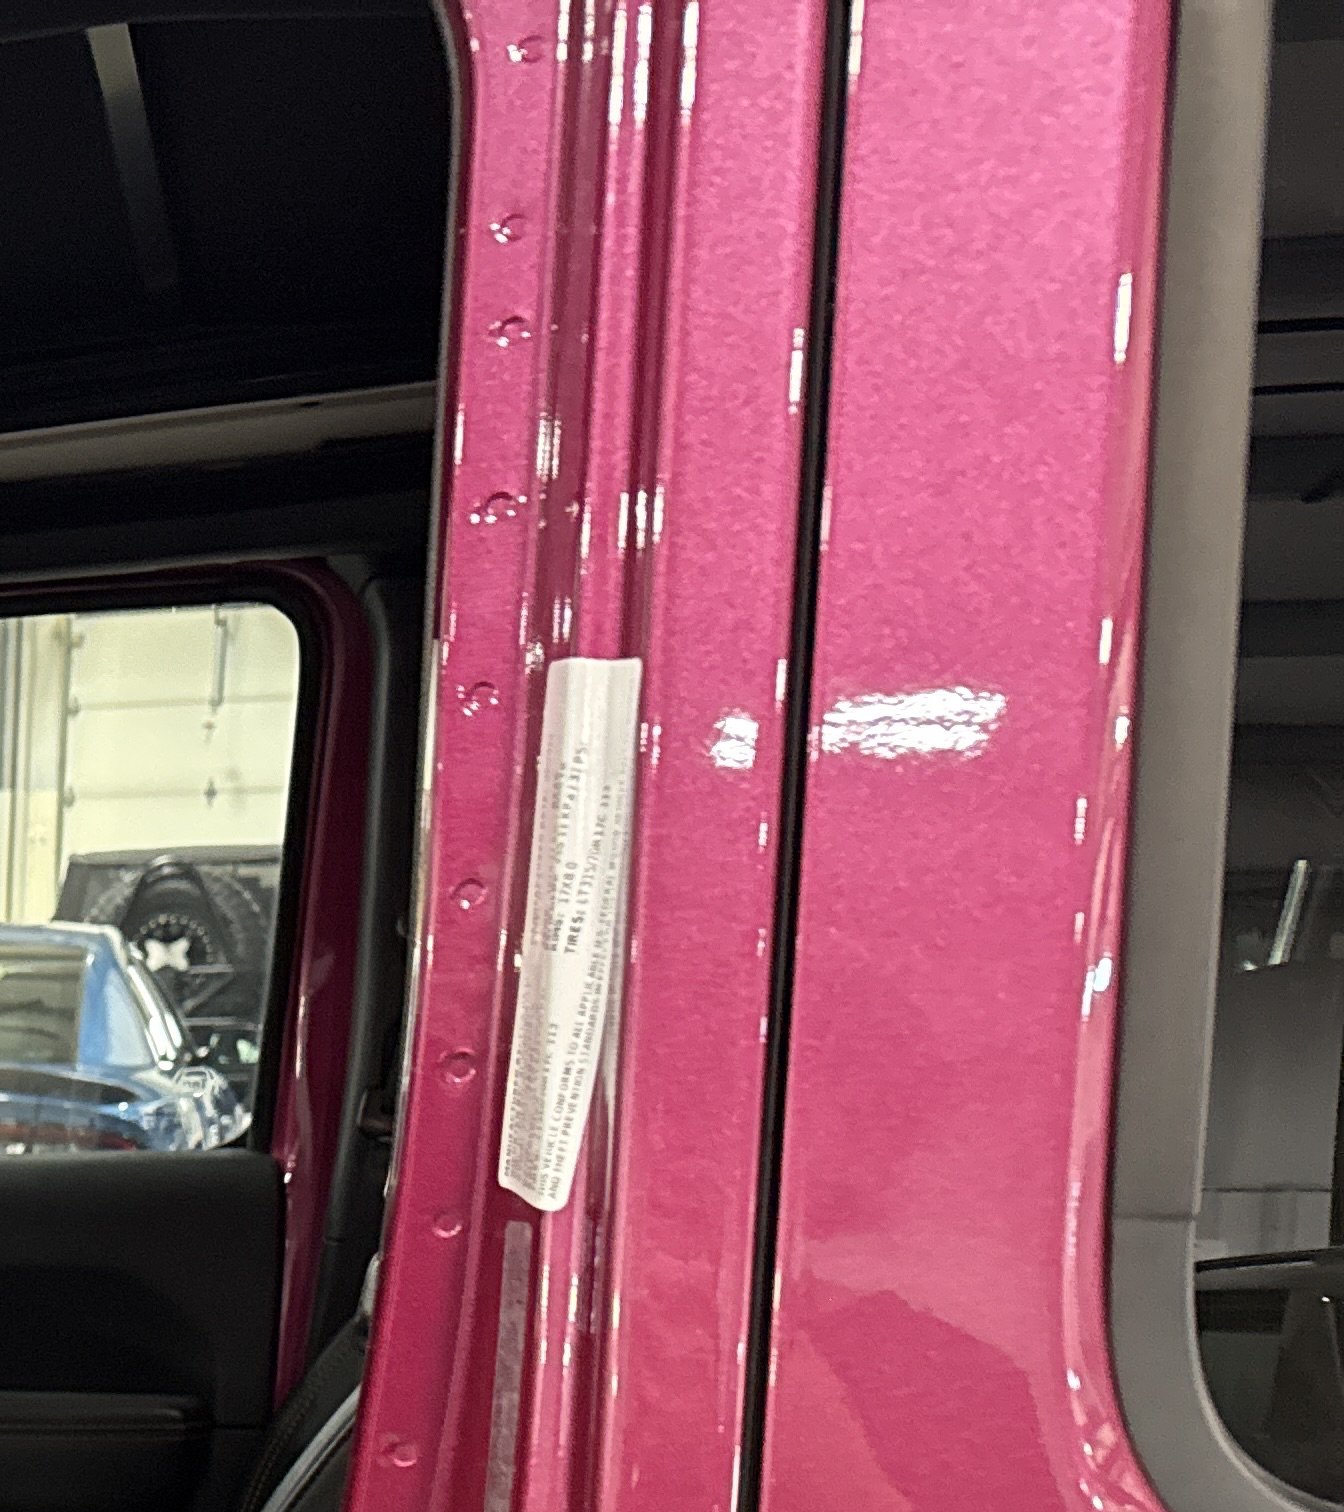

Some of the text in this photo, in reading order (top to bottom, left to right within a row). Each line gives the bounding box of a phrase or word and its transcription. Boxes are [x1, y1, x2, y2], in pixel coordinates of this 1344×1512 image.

[563, 911, 587, 953] TIRES:
[549, 1059, 574, 1122] CONFORMS
[561, 1067, 586, 1136] PREVENTION
[540, 1126, 559, 1170] VEHICLE
[553, 1139, 569, 1172] THEFT
[547, 1176, 560, 1199] AND
